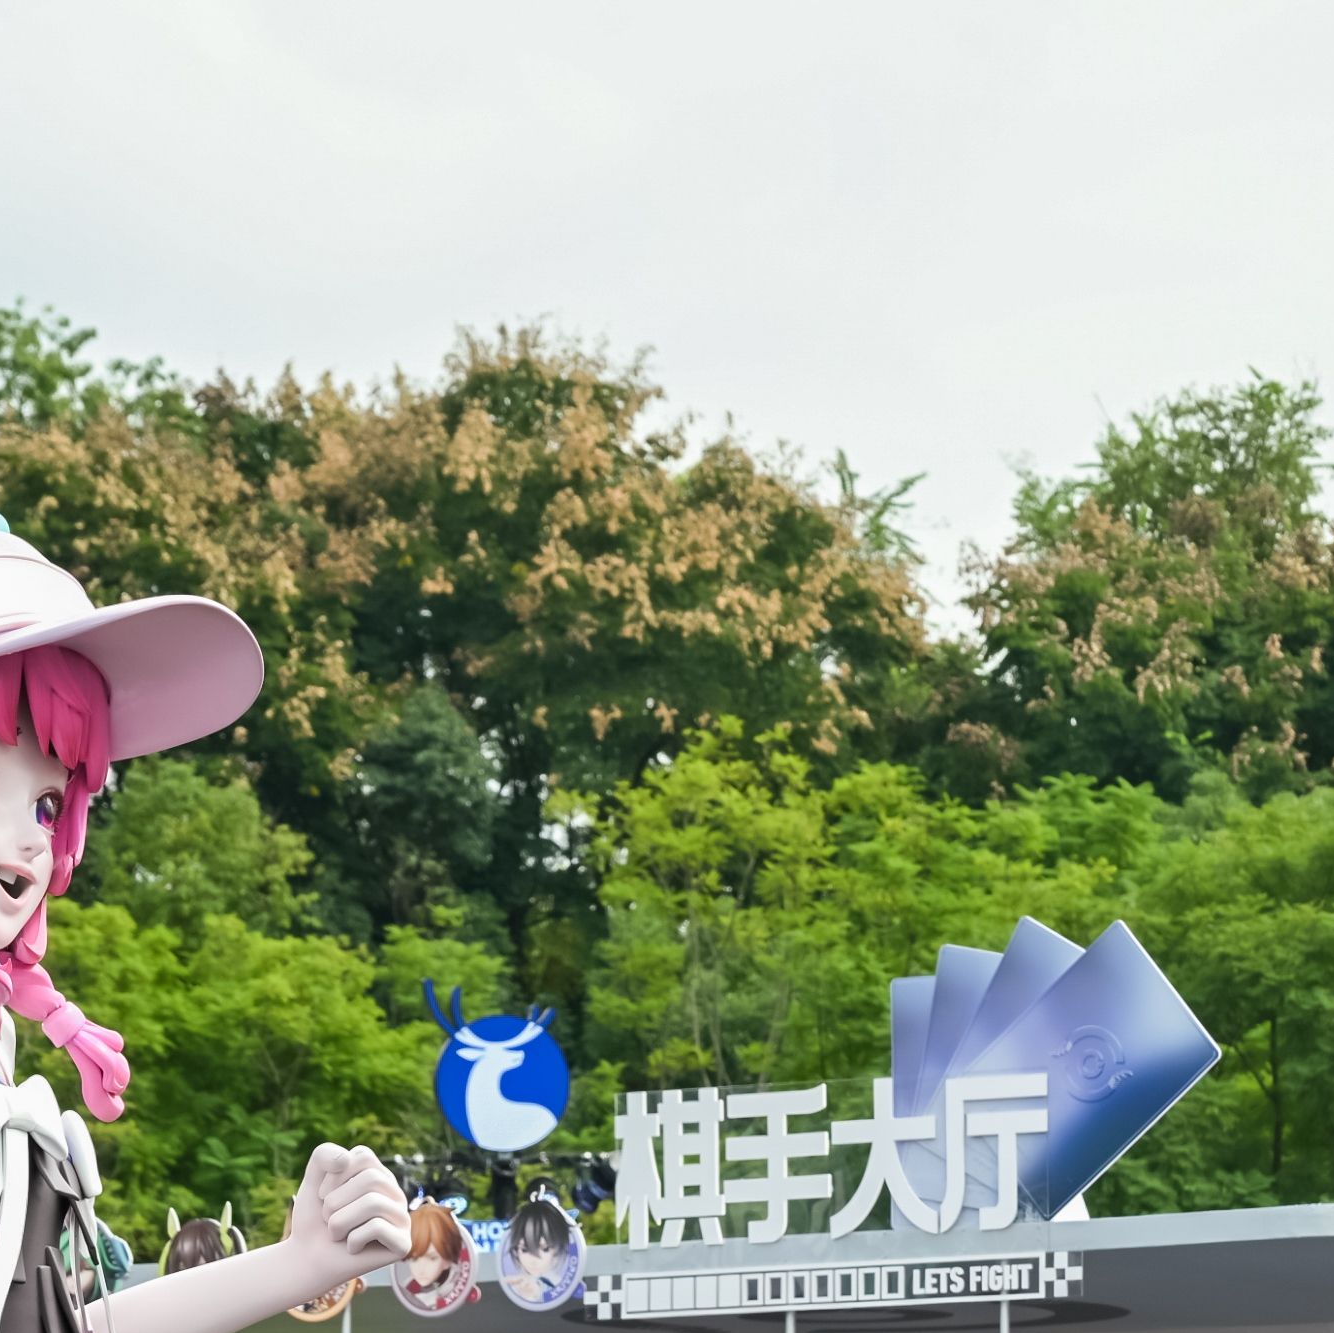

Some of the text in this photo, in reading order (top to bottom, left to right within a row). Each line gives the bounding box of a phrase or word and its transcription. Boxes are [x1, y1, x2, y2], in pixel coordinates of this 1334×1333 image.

[614, 1073, 1049, 1250] 棋手大厅
[912, 1263, 1033, 1295] LETS FIGHT
